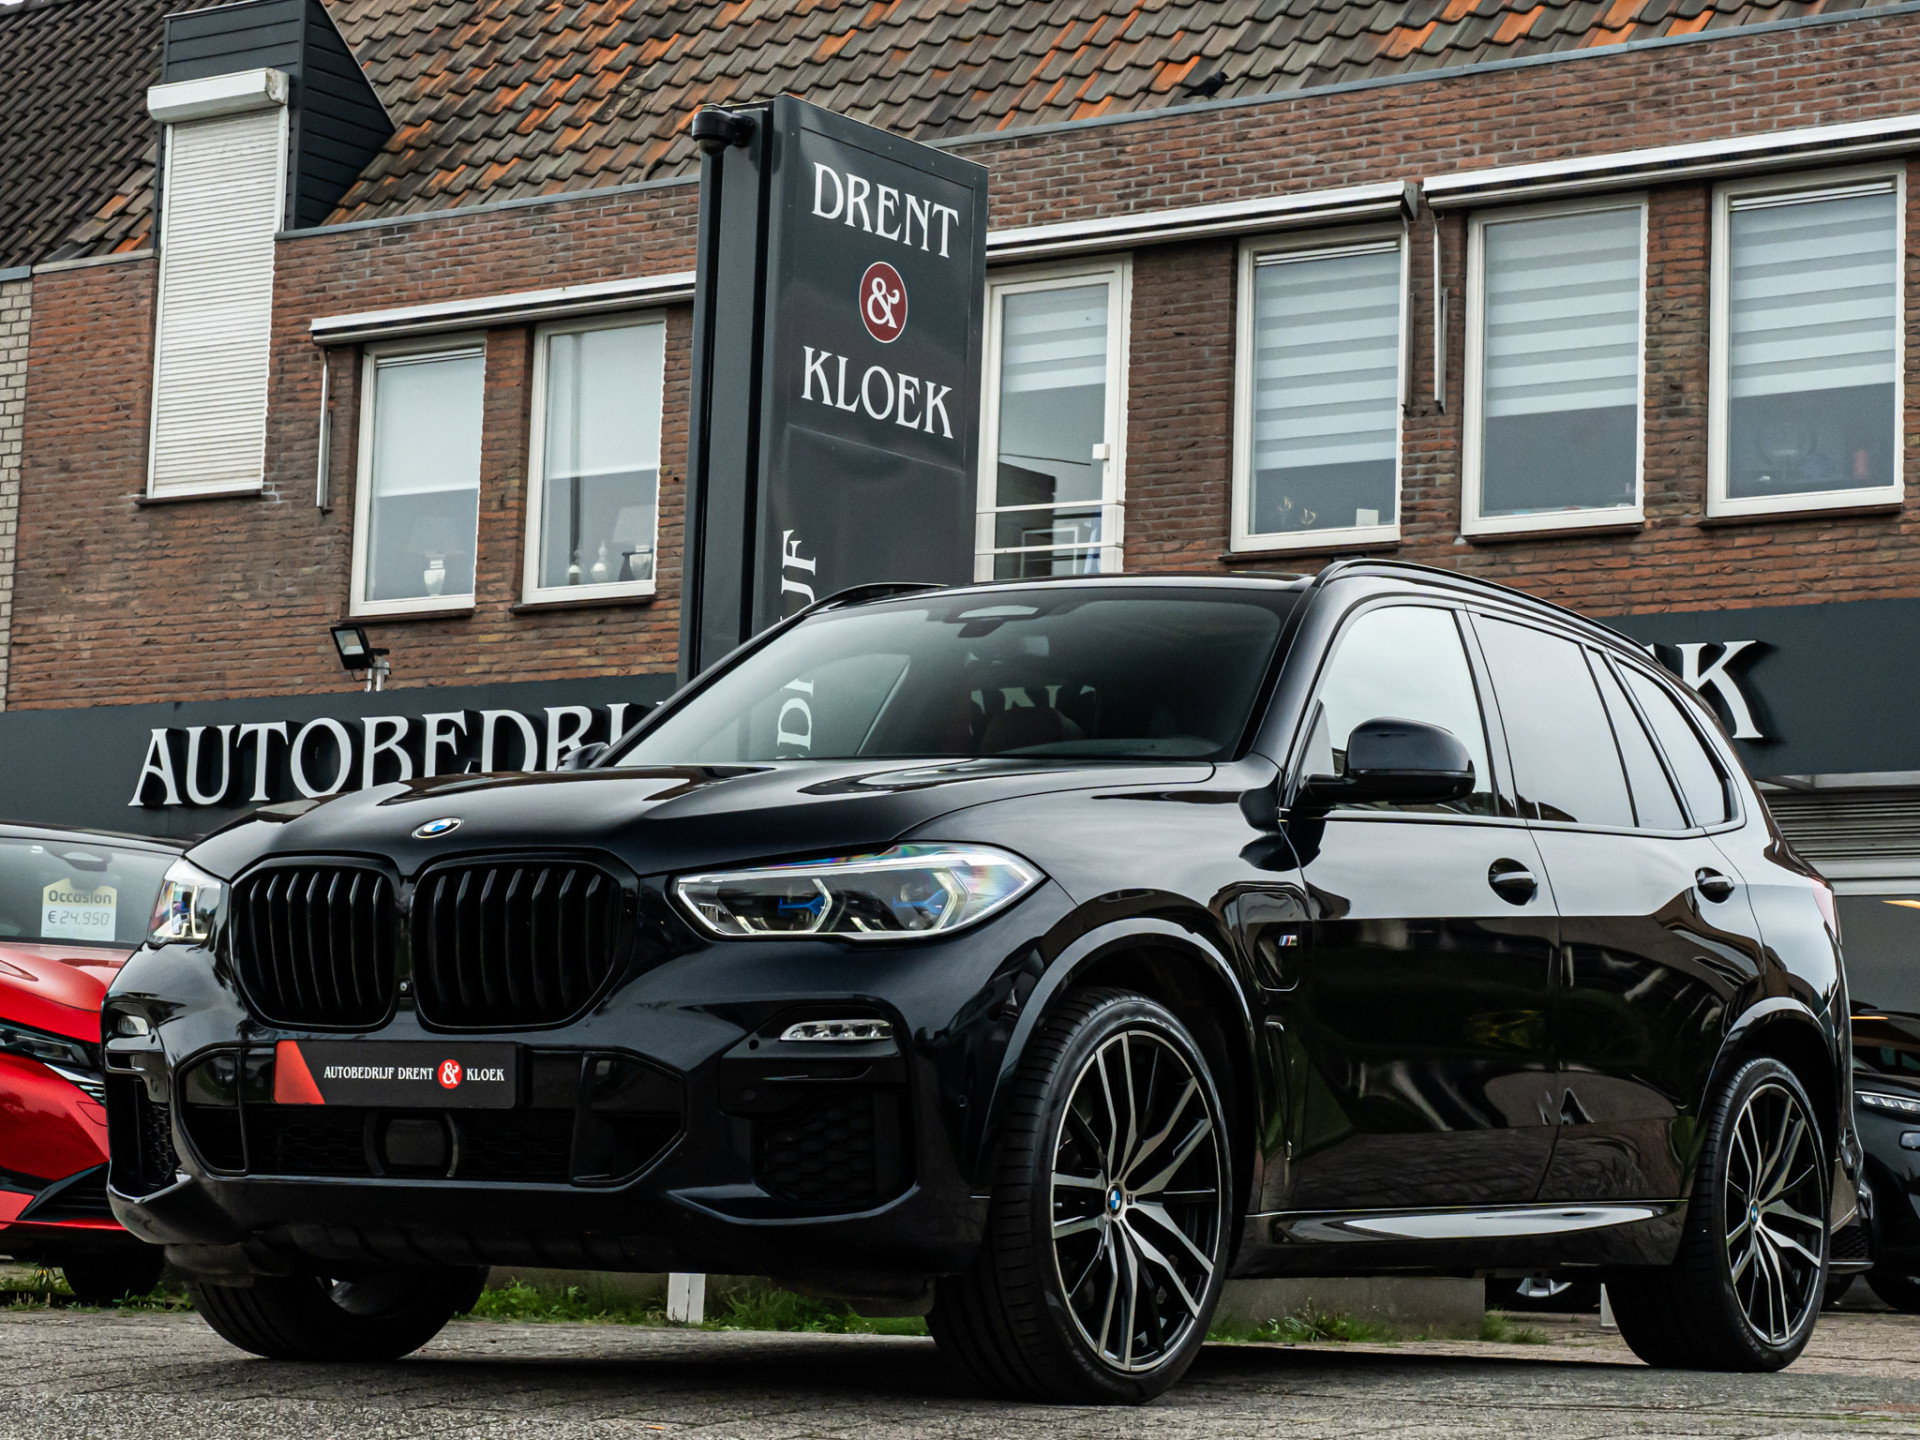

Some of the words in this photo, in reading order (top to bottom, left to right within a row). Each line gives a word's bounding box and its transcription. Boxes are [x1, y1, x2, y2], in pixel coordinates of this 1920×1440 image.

[812, 162, 959, 258] DRENT
[866, 277, 900, 329] &
[801, 345, 954, 440] KLOEK
[128, 701, 665, 807] AUTOBEDRI
[48, 889, 112, 904] Occasion
[324, 1066, 395, 1080] AUTOBEDRIJF
[397, 1067, 433, 1080] DRENT
[441, 1061, 459, 1084] &
[466, 1068, 505, 1082] KLOEK
